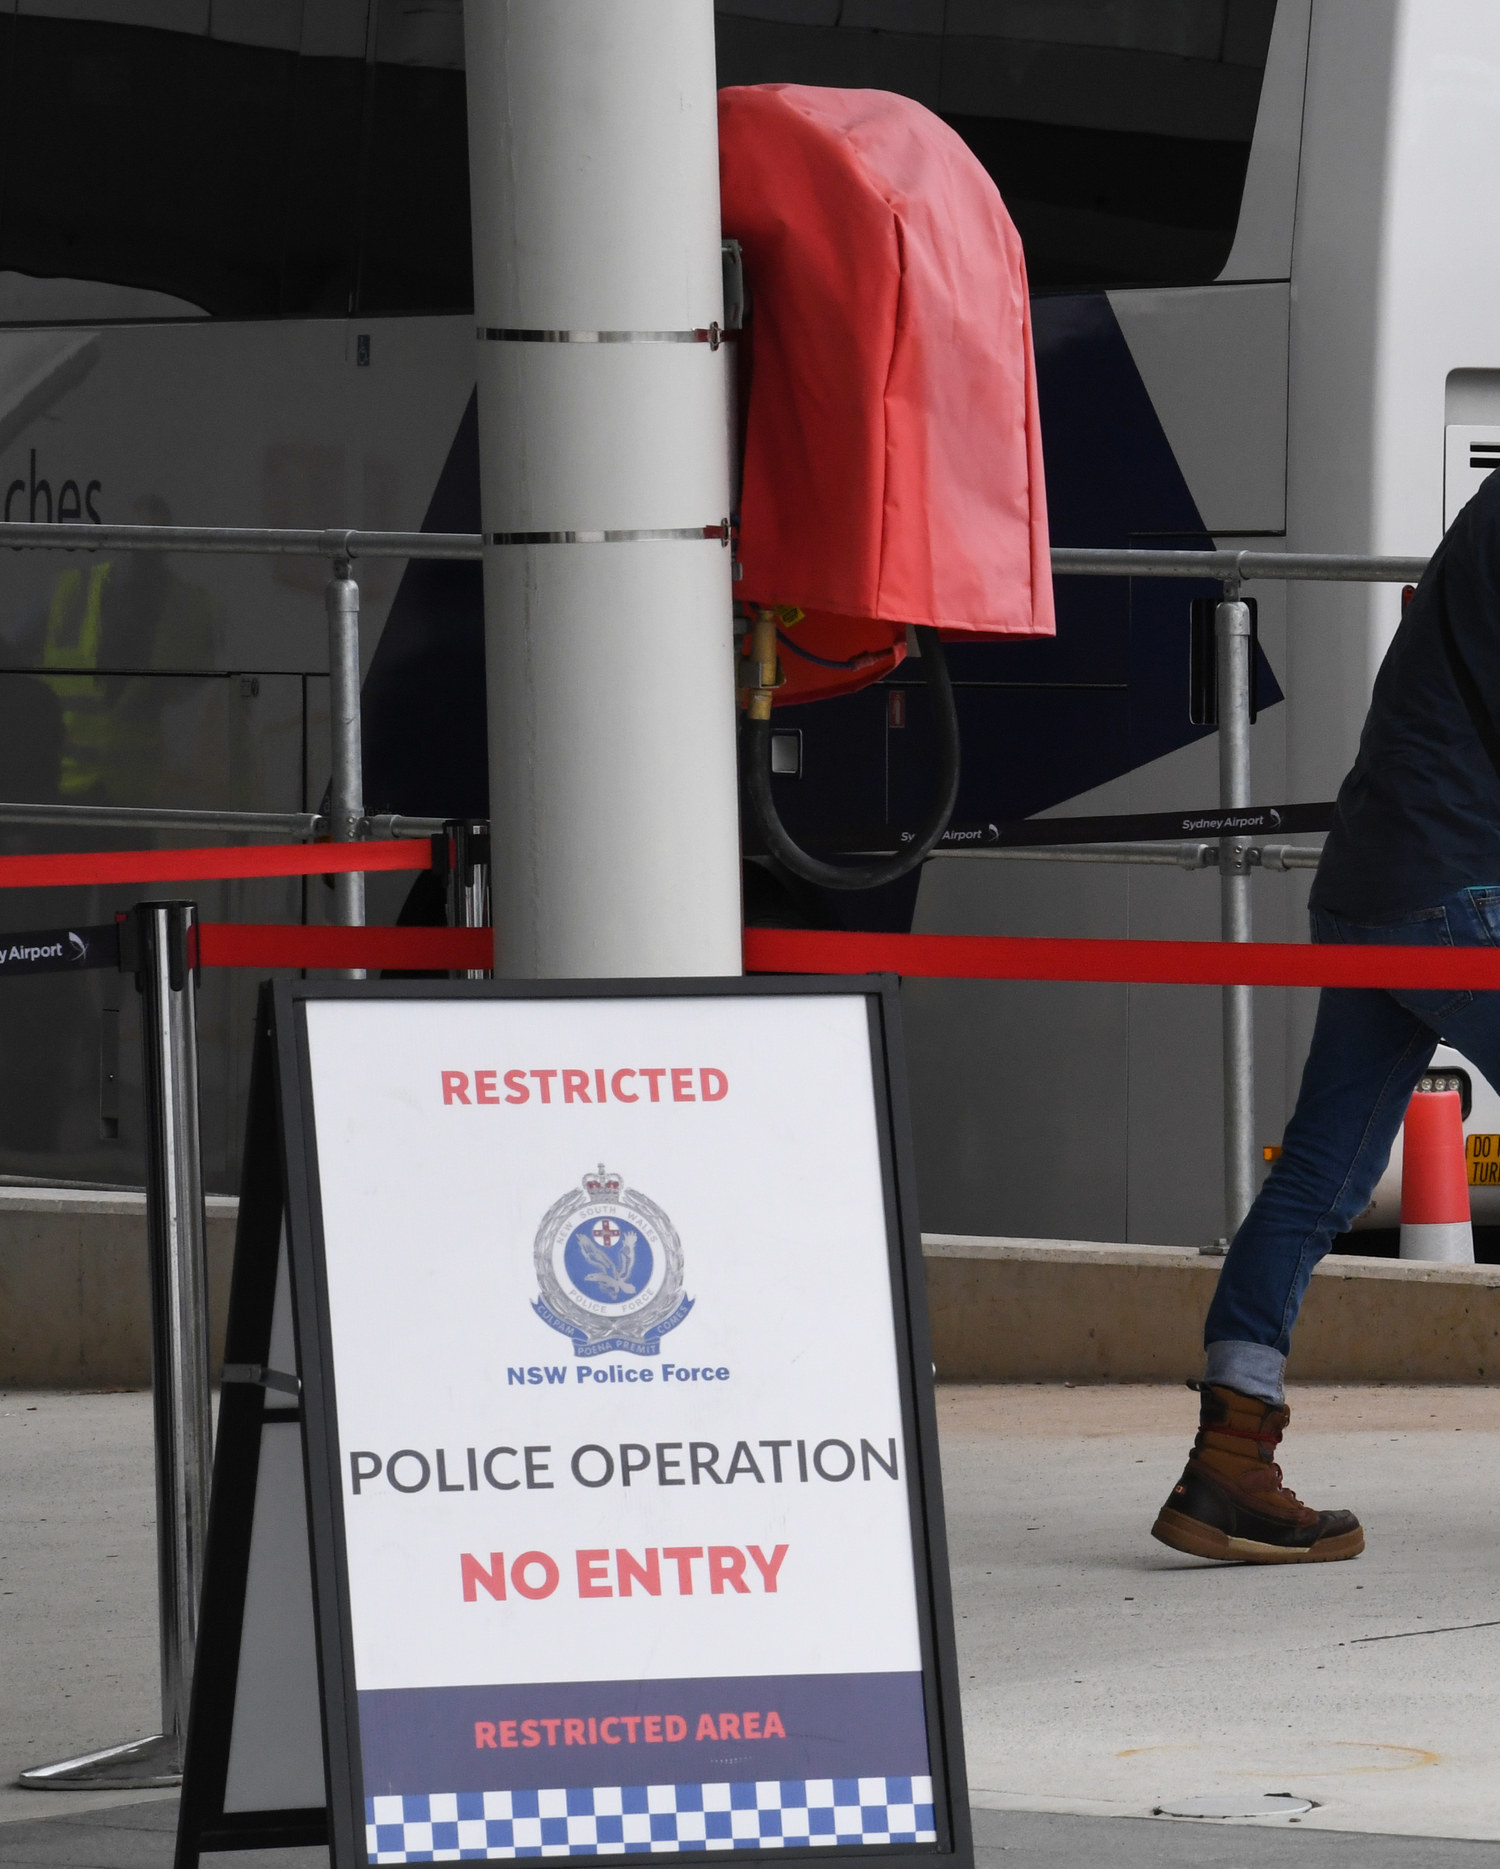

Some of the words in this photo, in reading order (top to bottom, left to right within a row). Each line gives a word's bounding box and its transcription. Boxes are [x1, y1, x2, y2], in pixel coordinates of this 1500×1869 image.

[941, 829, 983, 842] Airport
[1182, 818, 1224, 831] Sydney
[1223, 815, 1265, 829] Airport
[8, 943, 63, 962] Airport
[441, 1066, 730, 1106] RESTRICTED
[1473, 1136, 1491, 1158] DO
[556, 1223, 574, 1245] NEW
[580, 1206, 617, 1220] SOUTH
[627, 1212, 659, 1243] WALES
[568, 1289, 608, 1314] POLICE
[622, 1288, 656, 1313] FORCE
[537, 1305, 577, 1336] CULPAM
[577, 1341, 613, 1356] POENA
[616, 1340, 657, 1354] PREMIT
[657, 1305, 688, 1334] COMES
[507, 1366, 567, 1385] NSW
[577, 1365, 654, 1384] Police
[662, 1364, 730, 1382] Force
[349, 1444, 554, 1495] POLICE
[570, 1437, 900, 1488] OPERATION
[460, 1550, 560, 1602] NO
[575, 1544, 790, 1599] ENTRY
[474, 1715, 688, 1749] RESTRICTED
[696, 1711, 787, 1741] AREA
